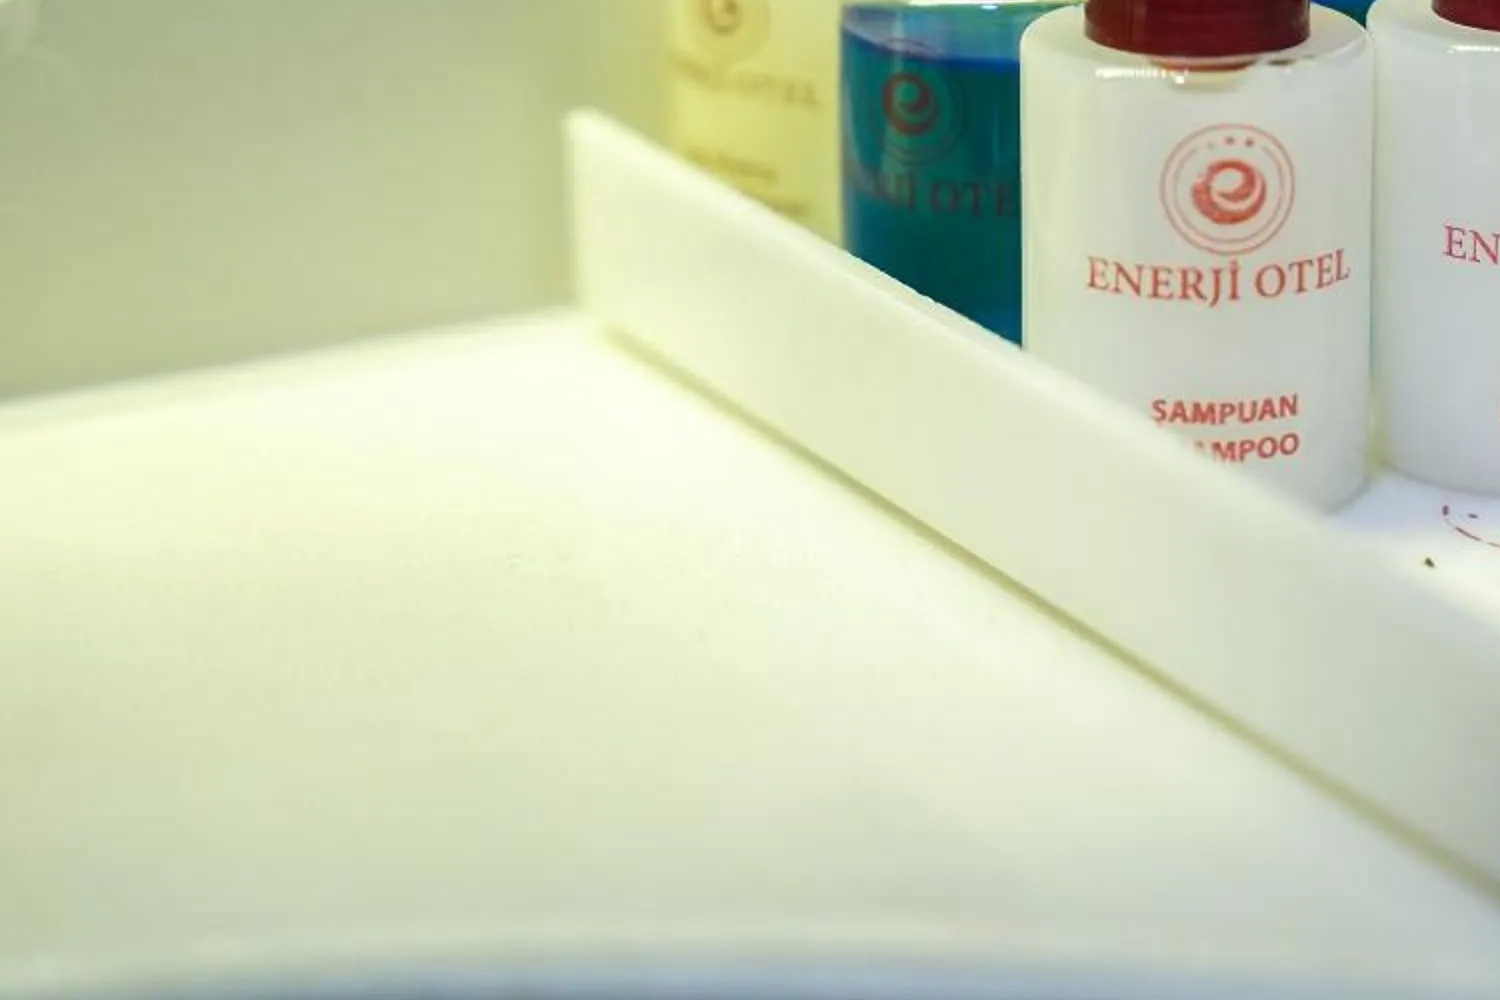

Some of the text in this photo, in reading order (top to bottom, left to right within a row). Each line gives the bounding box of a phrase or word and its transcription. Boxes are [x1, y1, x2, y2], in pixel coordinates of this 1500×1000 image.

[1087, 248, 1350, 308] ENERJİ OTEL
[1194, 432, 1301, 463] MPOO
